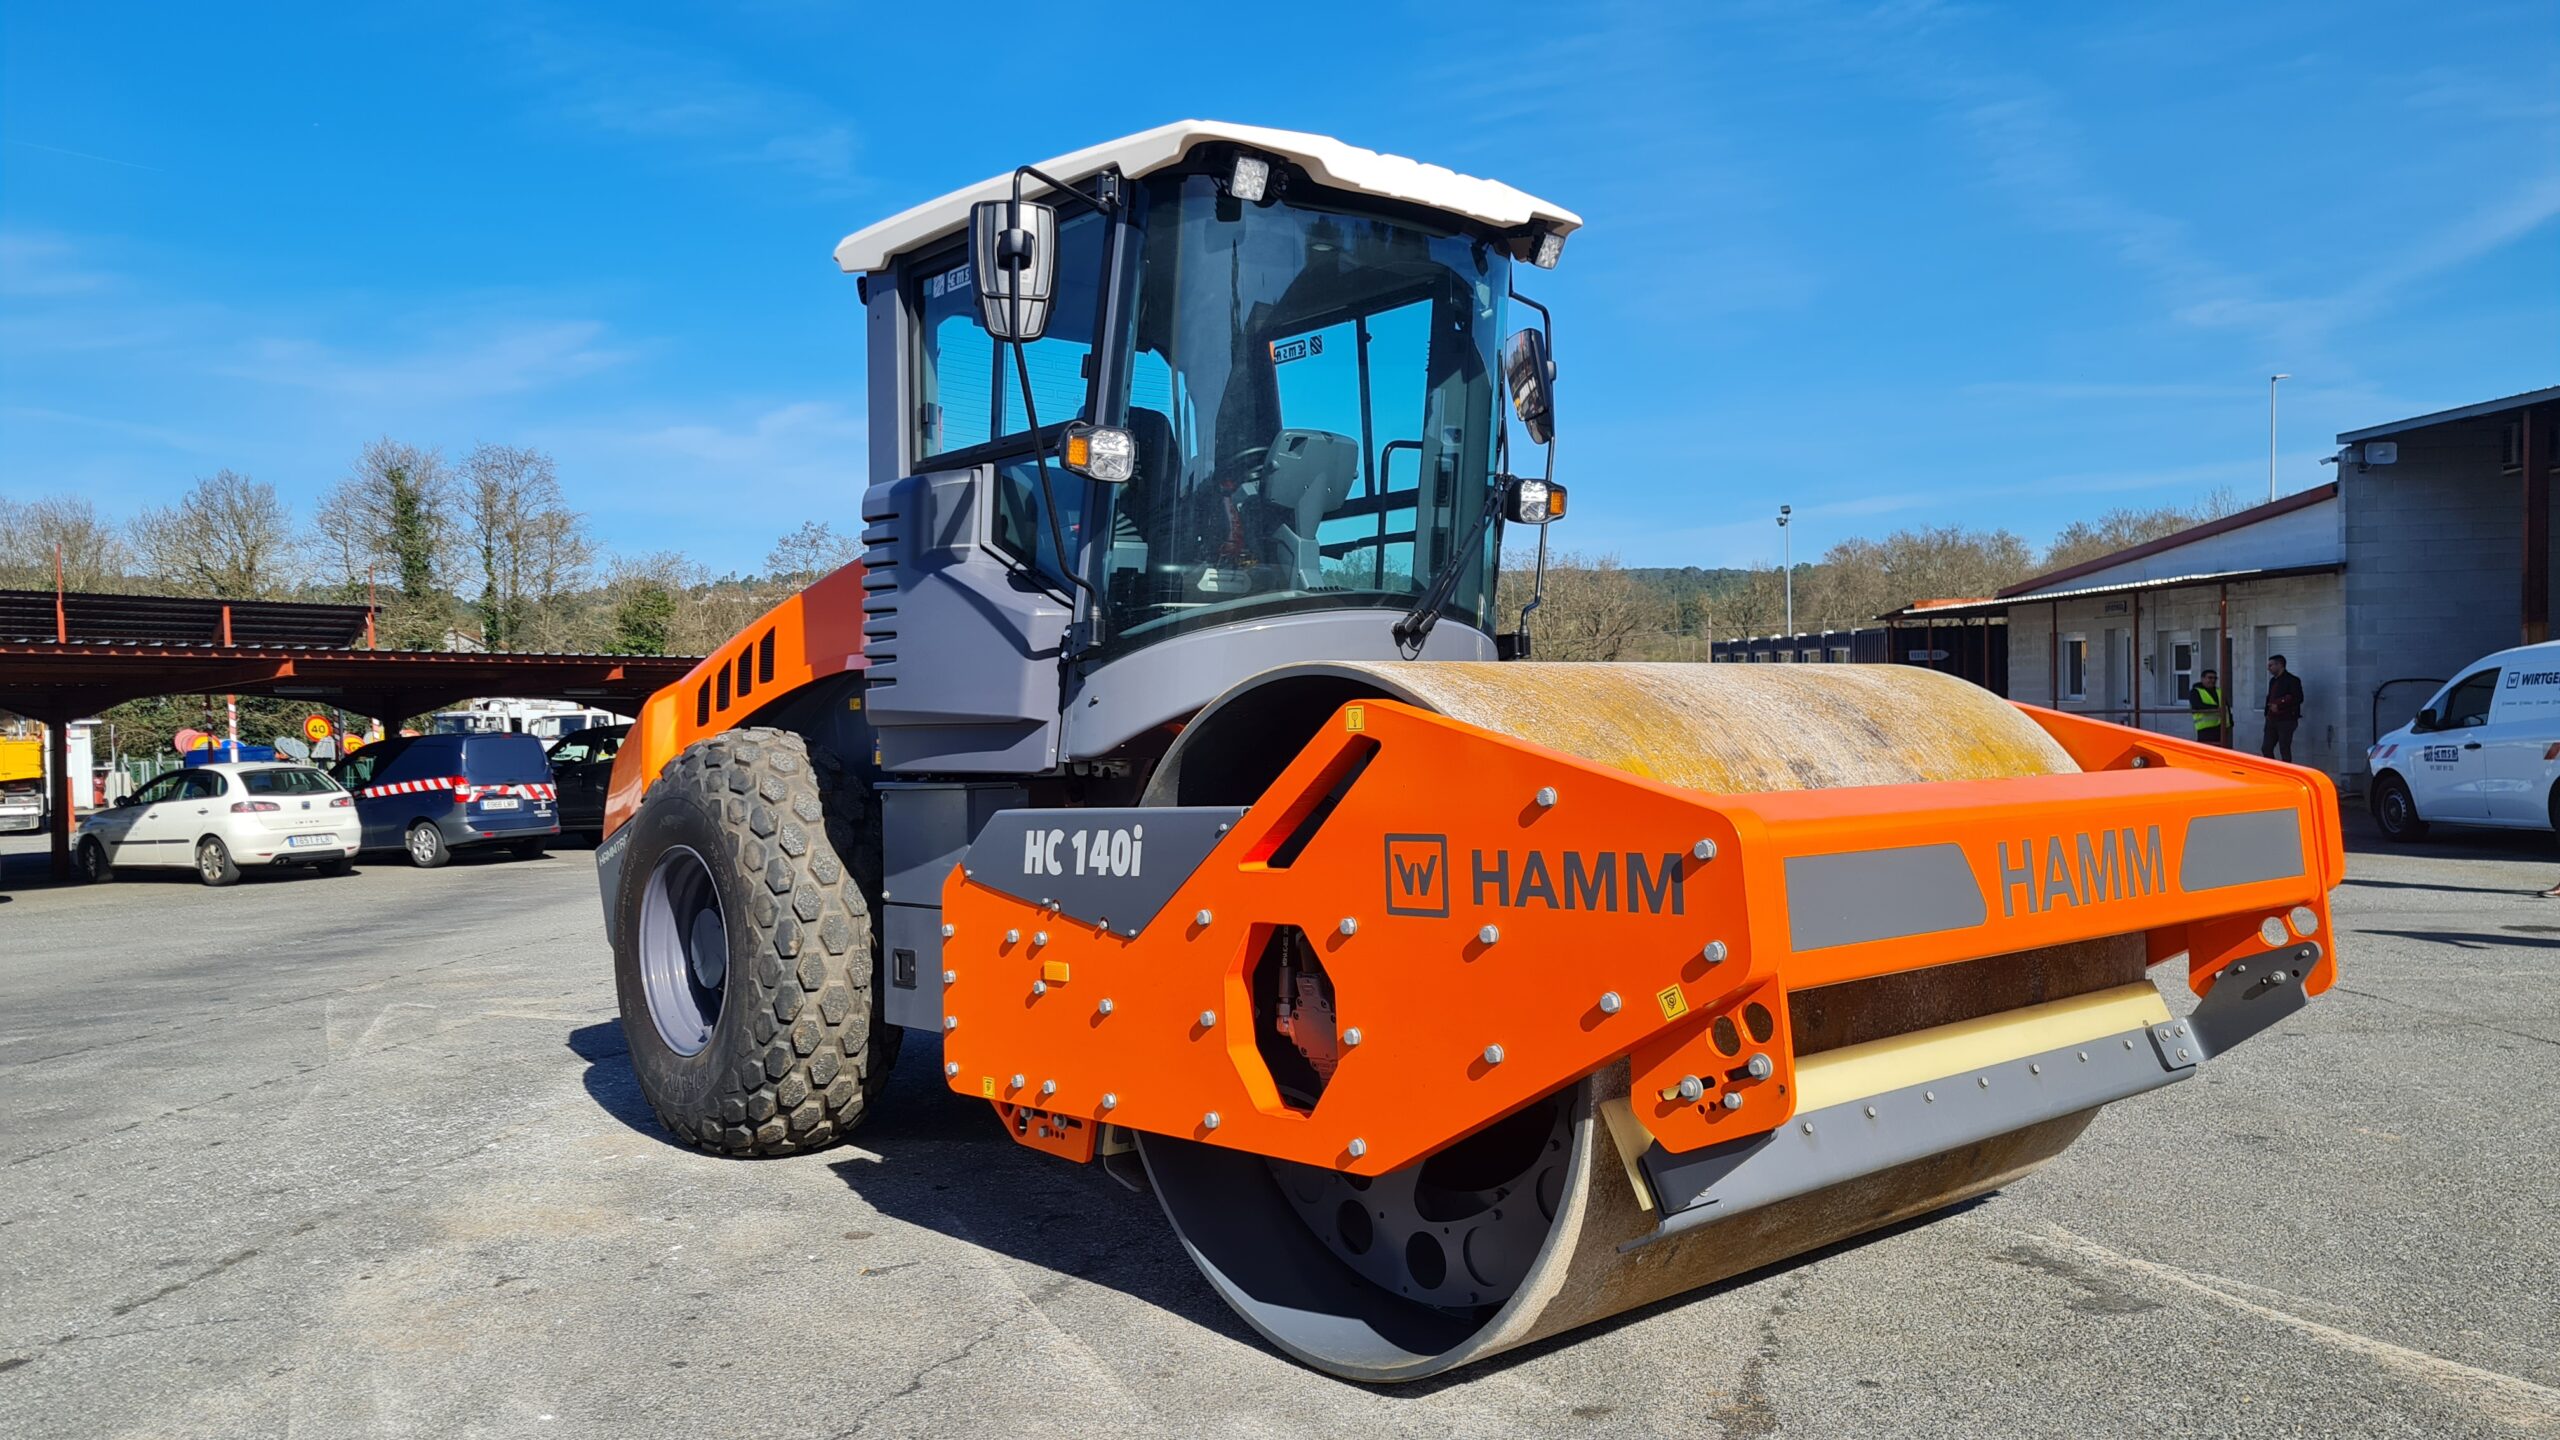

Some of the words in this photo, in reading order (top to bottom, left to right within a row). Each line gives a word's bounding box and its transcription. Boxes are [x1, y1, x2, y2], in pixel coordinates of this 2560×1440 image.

[2521, 671, 2560, 686] WIRTGE
[311, 724, 326, 734] 40
[1024, 829, 1065, 876] HC
[1071, 824, 1143, 877] 140i
[1997, 824, 2167, 918] HAMM
[1471, 849, 1685, 915] HAMM
